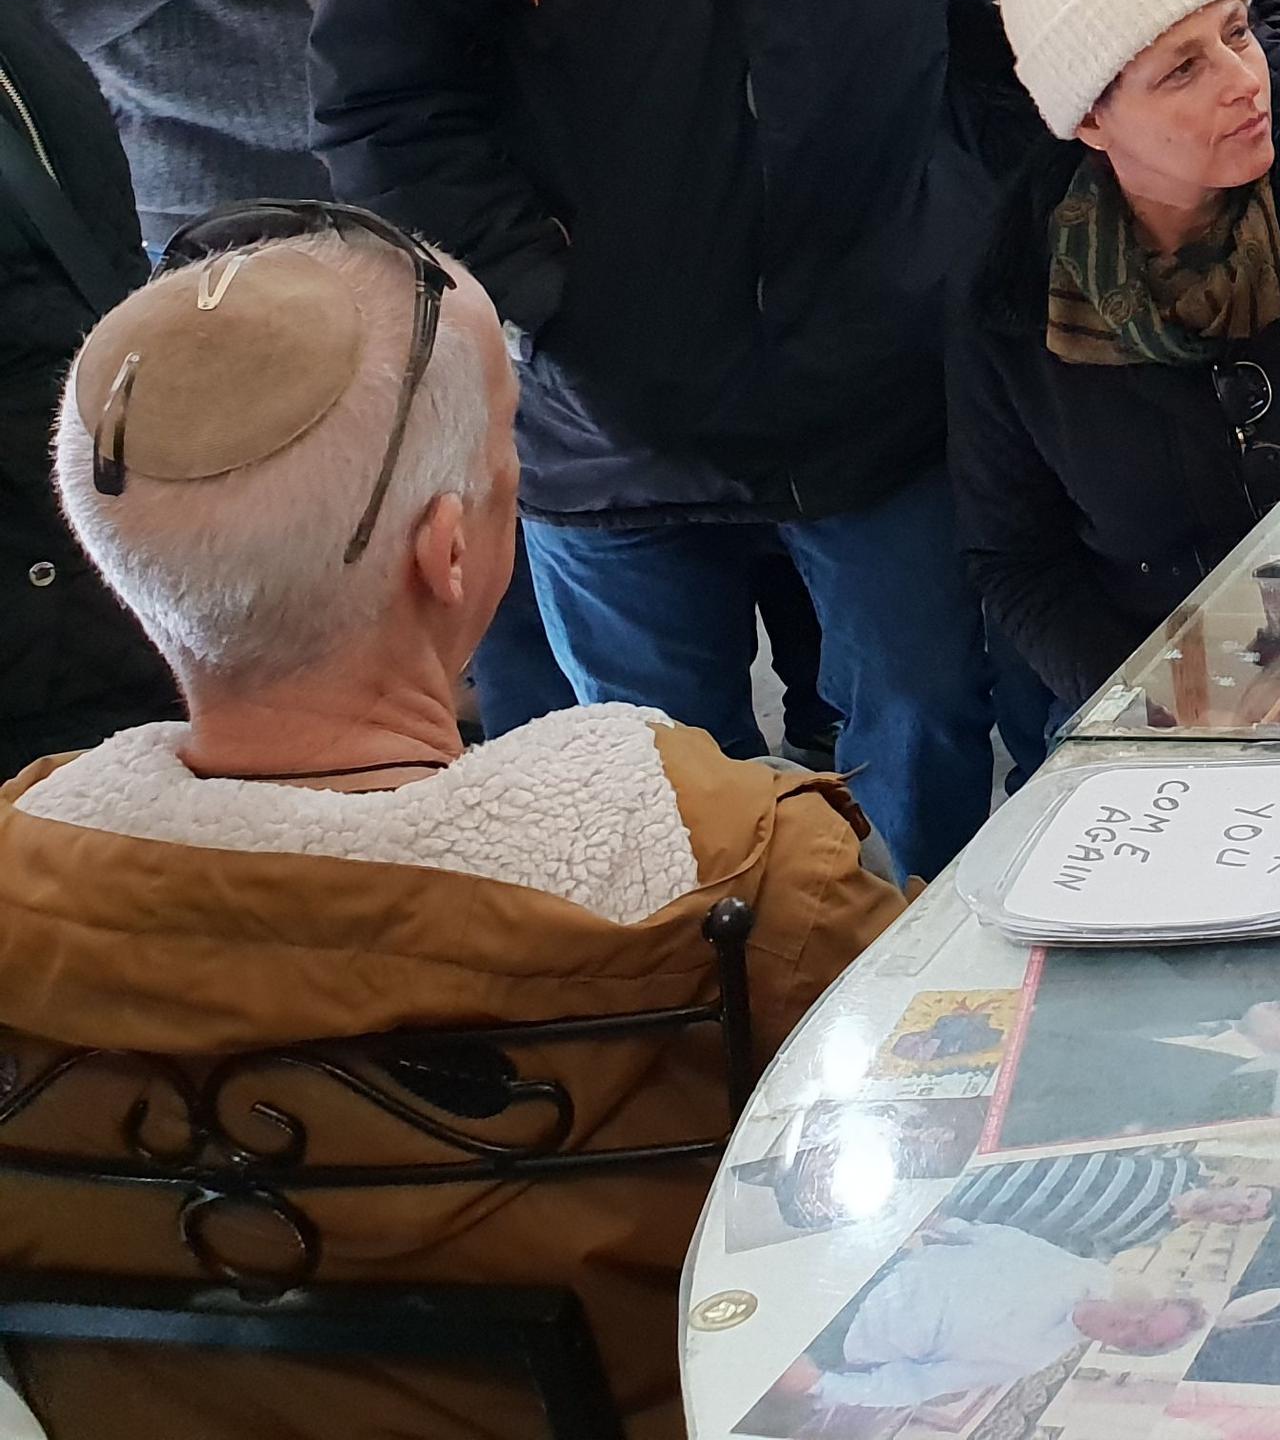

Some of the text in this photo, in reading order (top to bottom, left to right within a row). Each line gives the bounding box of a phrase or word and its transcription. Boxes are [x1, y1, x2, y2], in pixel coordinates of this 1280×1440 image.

[1053, 805, 1132, 892] AGAIN
[1113, 779, 1190, 863] COME
[1215, 802, 1275, 868] YOU
